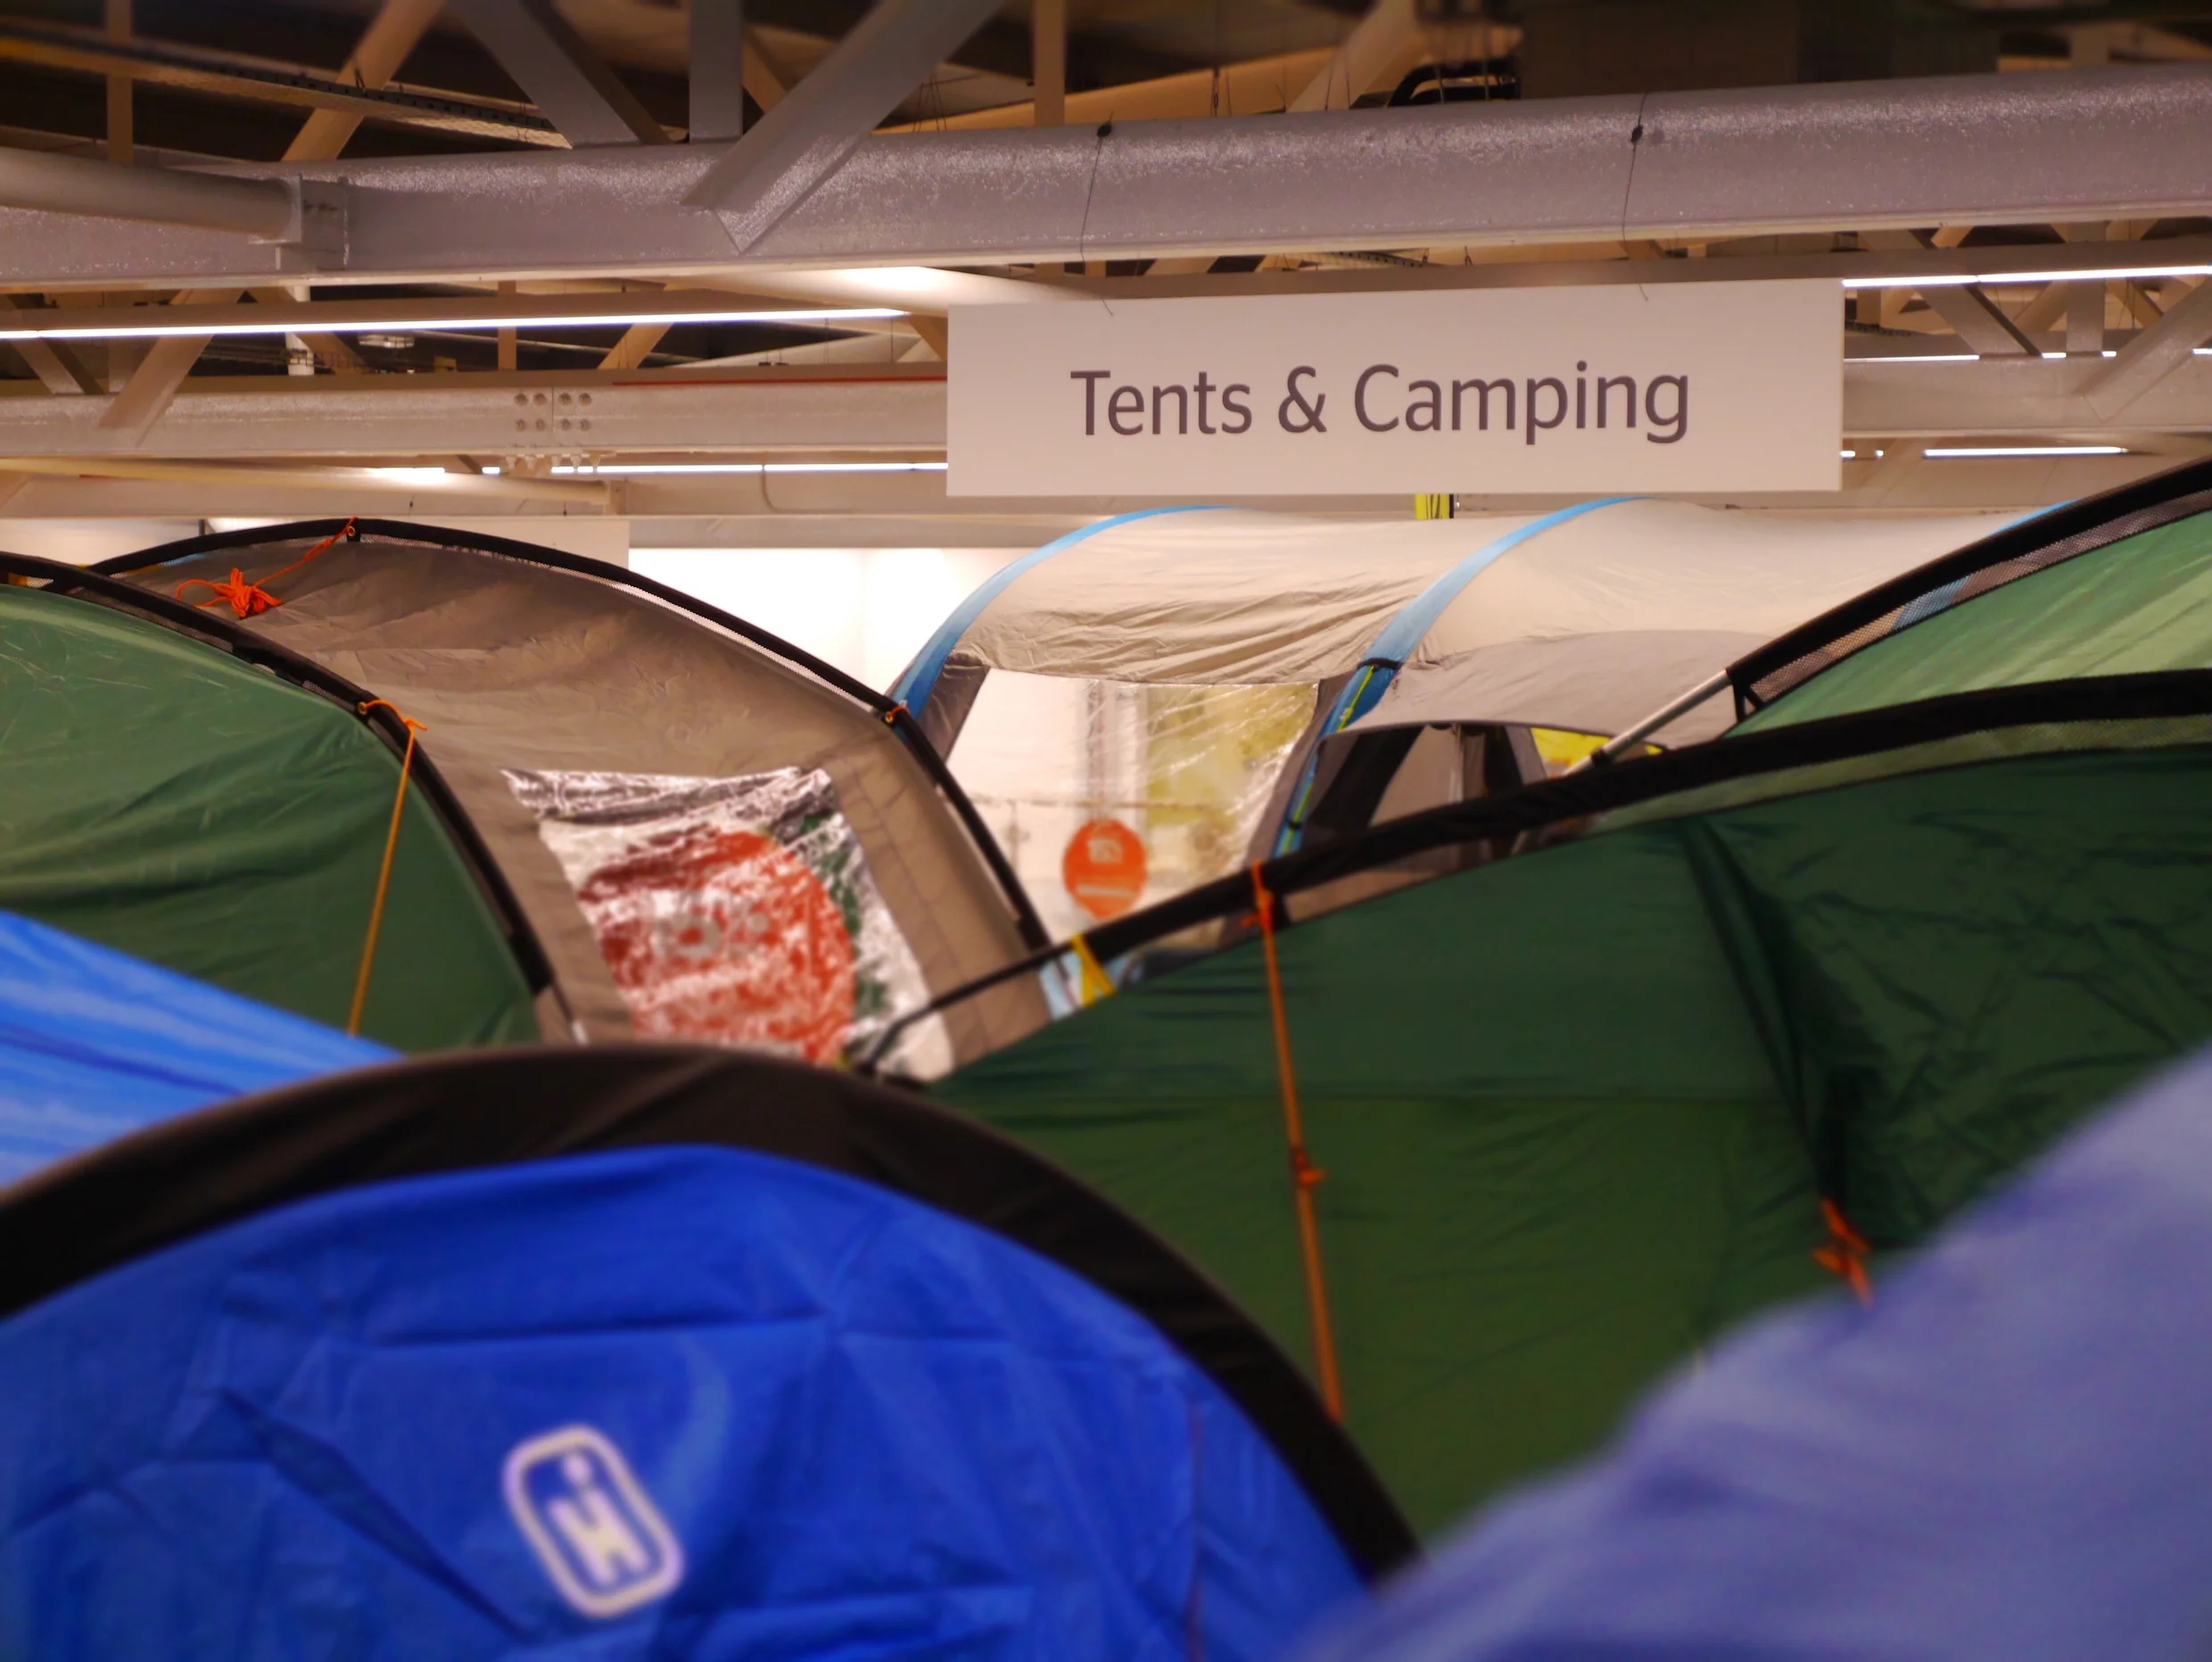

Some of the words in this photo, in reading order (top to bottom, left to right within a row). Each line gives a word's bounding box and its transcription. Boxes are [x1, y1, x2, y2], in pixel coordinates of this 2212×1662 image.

[1069, 365, 1253, 436] Tents
[1276, 364, 1328, 434] &
[1353, 359, 1689, 446] Camping
